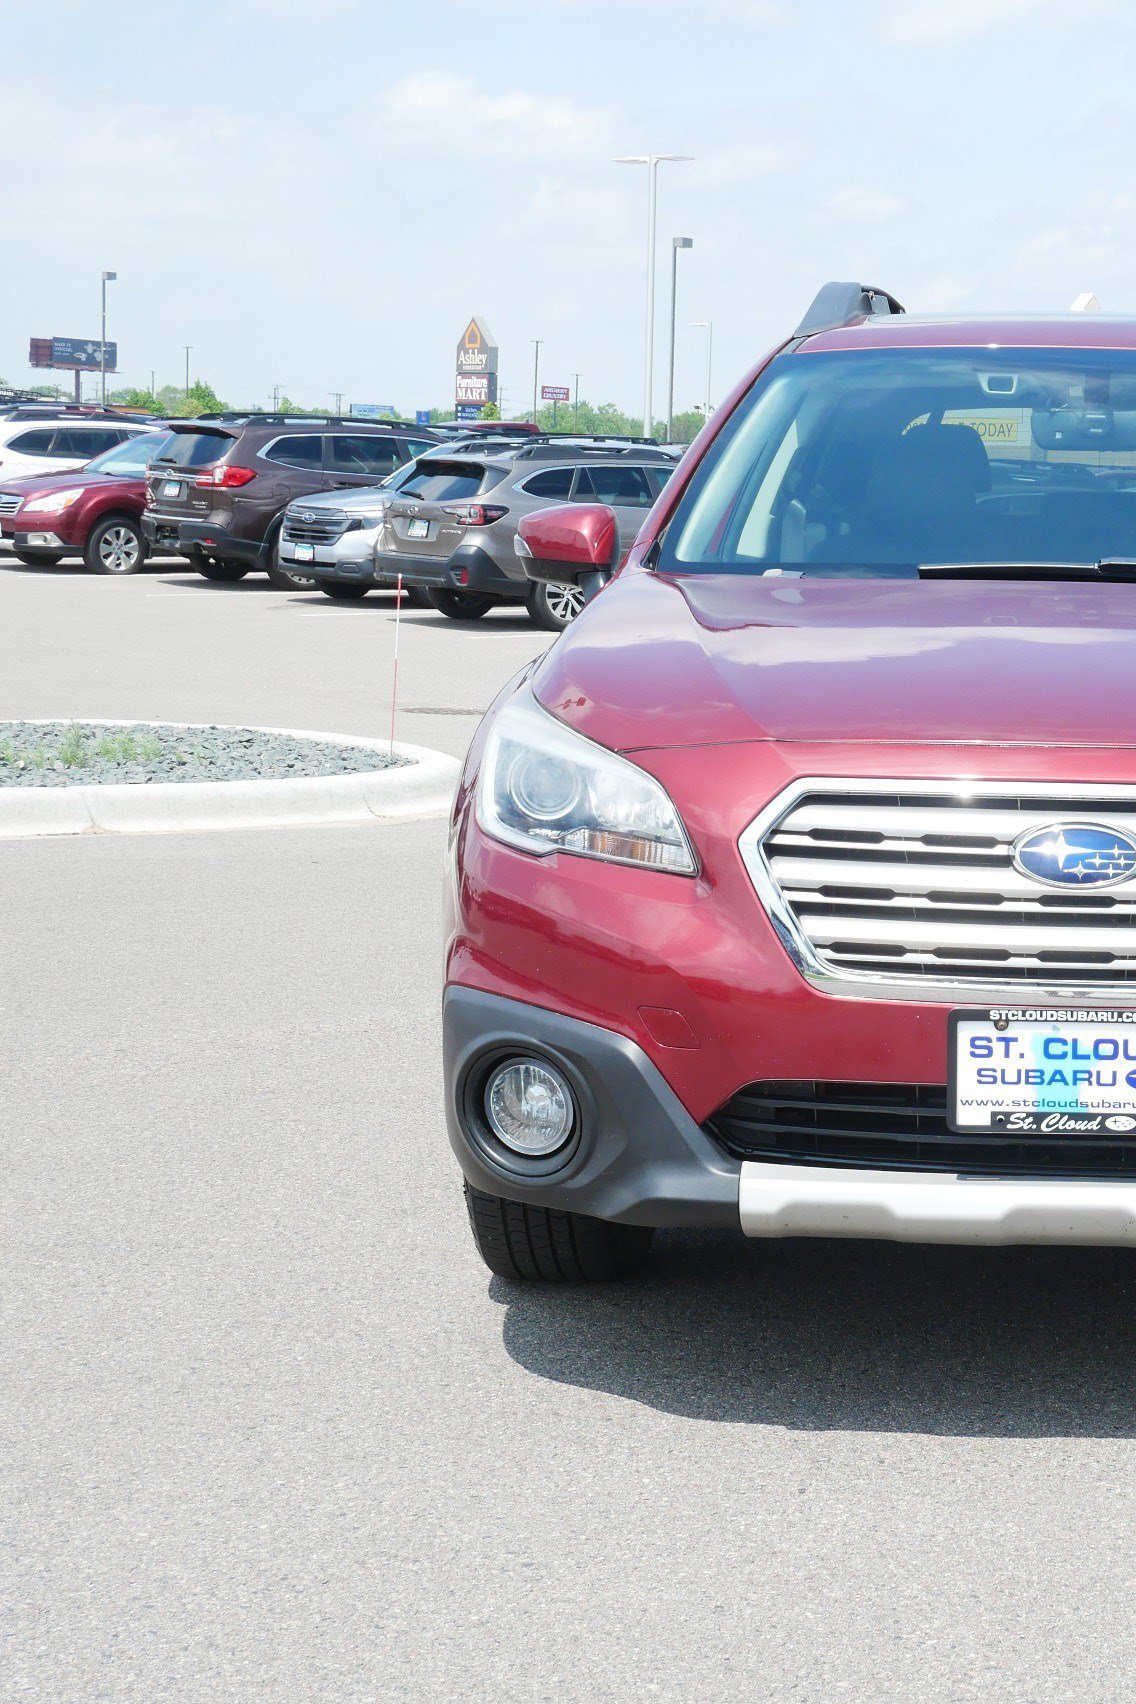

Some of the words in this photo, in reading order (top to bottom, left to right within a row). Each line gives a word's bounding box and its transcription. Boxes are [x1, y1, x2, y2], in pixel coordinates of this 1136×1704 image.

[458, 349, 487, 368] Ashley
[457, 376, 488, 388] Furniture
[457, 388, 487, 400] MART
[969, 1036, 1025, 1059] ST.
[976, 1067, 1117, 1087] SUBARU
[1007, 1112, 1038, 1130] St.
[1040, 1112, 1102, 1132] Cloud
